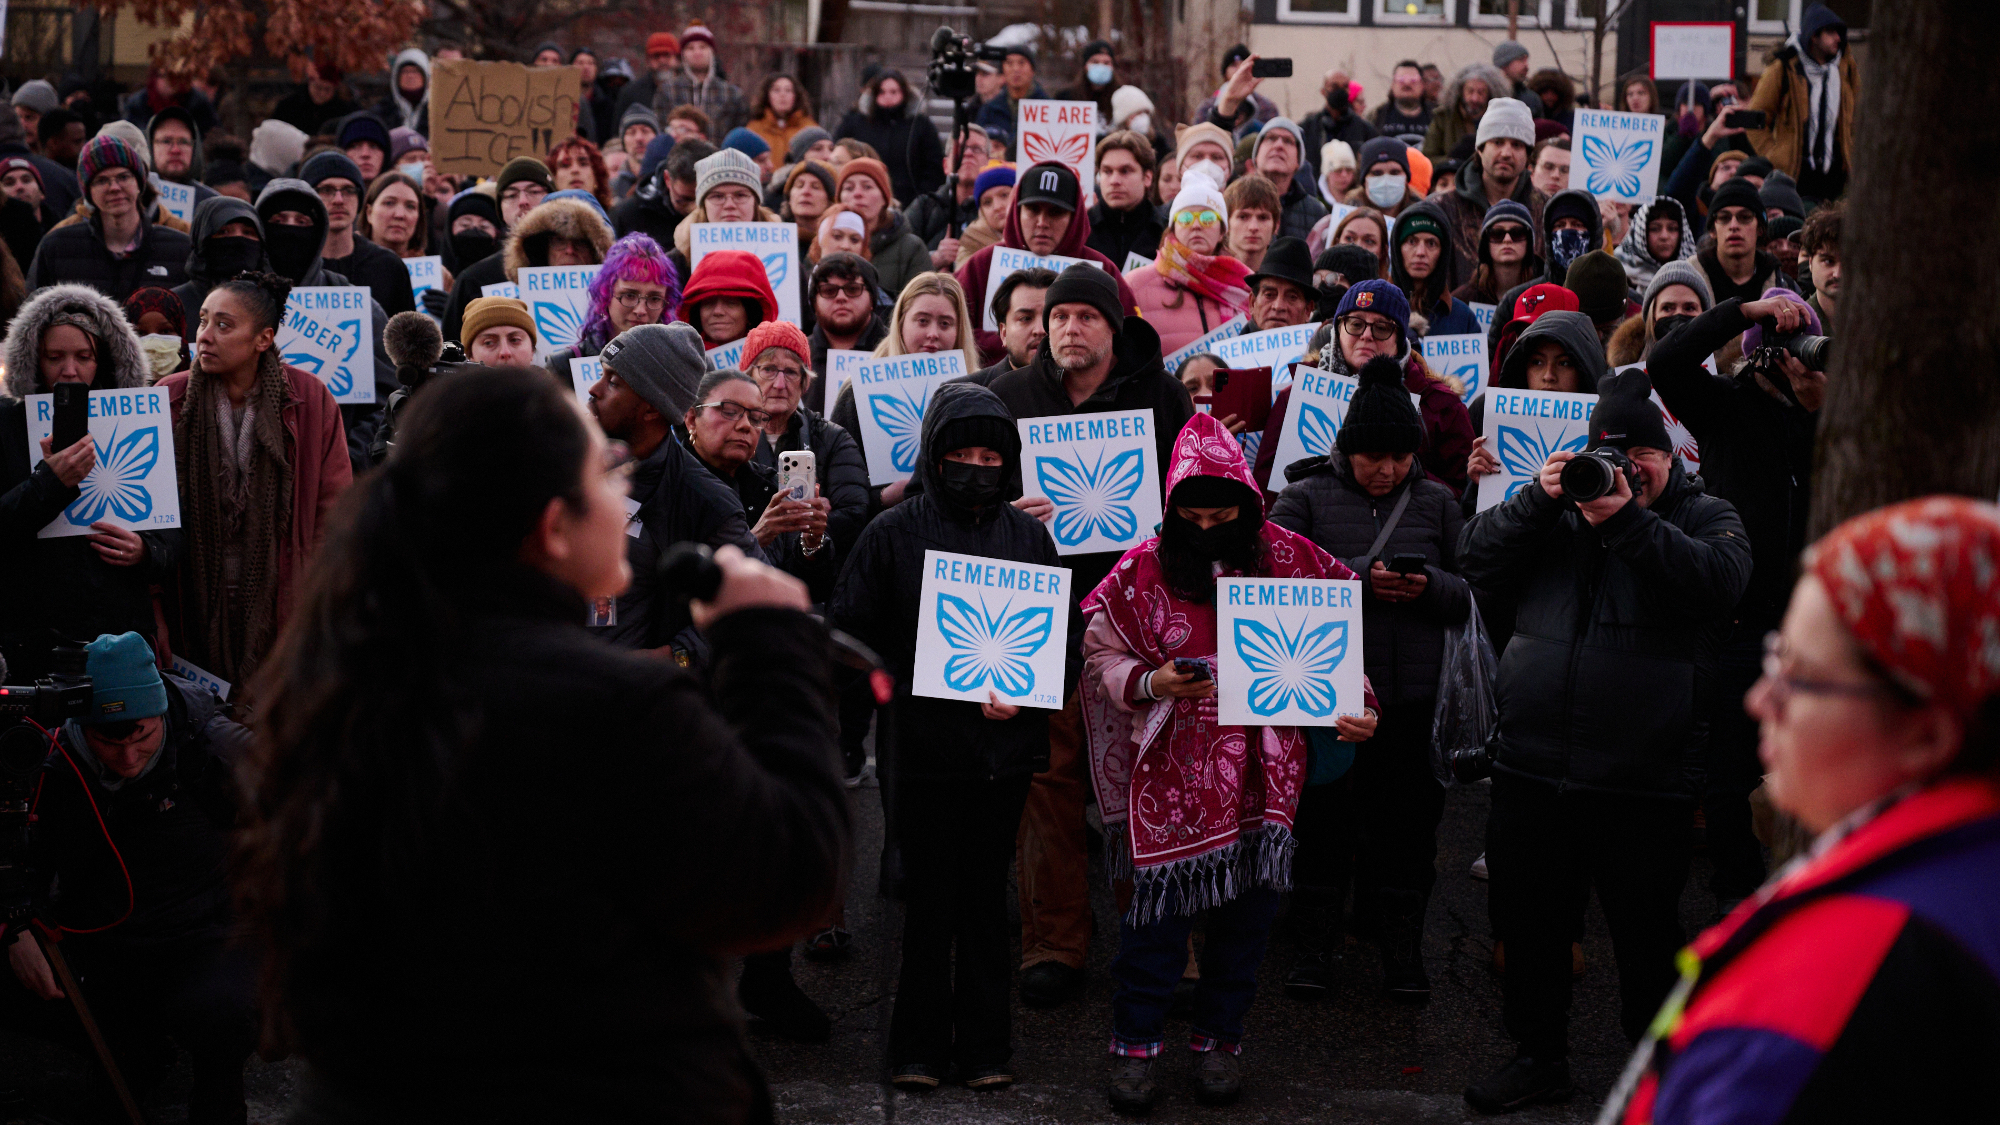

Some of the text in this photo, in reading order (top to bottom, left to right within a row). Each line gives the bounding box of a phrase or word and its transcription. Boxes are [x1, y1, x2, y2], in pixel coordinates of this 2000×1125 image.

[443, 75, 574, 128] Abolish
[1023, 105, 1092, 124] WE ARE
[1581, 113, 1659, 132] REMEMBER
[699, 227, 791, 244] REMEMBER
[528, 270, 594, 291] REMEM
[288, 292, 364, 309] MEMBER
[1422, 338, 1482, 357] EMBER
[859, 355, 960, 385] REMEMBER
[1301, 372, 1356, 403] REME
[37, 393, 161, 422] REMBER
[1495, 394, 1597, 422] REMEMBE
[1028, 416, 1146, 445] REMEMBER
[153, 514, 175, 524] 1.7.26
[935, 558, 1061, 595] REMEMBER
[1228, 584, 1353, 608] REMEMBER
[1033, 694, 1057, 704] 1.7.26
